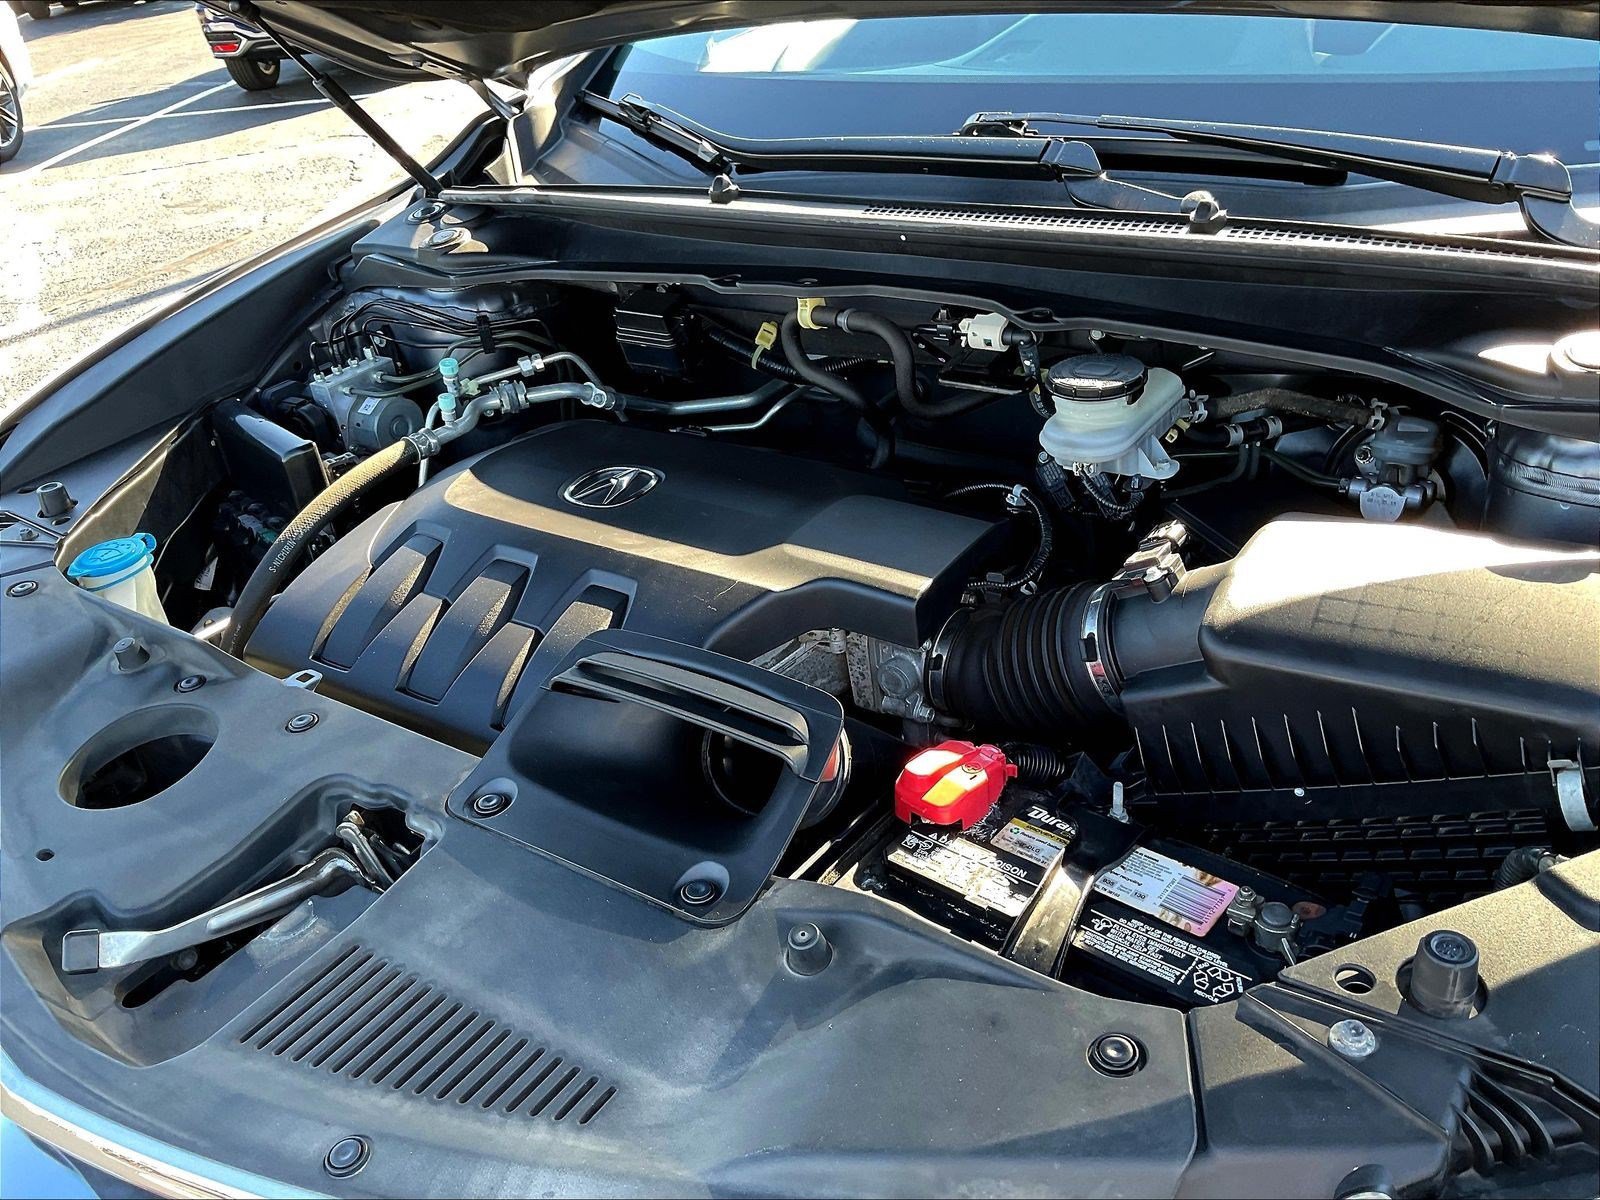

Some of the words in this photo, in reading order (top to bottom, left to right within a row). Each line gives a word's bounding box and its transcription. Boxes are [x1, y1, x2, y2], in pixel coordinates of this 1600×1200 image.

[1027, 805, 1076, 835] Dural
[995, 859, 1028, 878] OISON
[1106, 932, 1130, 947] MEDICAL
[1131, 942, 1147, 953] HELP
[1147, 950, 1164, 960] FAST
[1110, 928, 1125, 940] WITH
[1146, 943, 1160, 953] GET
[1112, 923, 1132, 936] FLUSH
[1132, 931, 1147, 942] EYES
[1147, 938, 1186, 959] IMMEDIATELY
[1127, 921, 1138, 929] NOT
[1202, 953, 1213, 962] AND
[1161, 964, 1181, 976] FOLLOW
